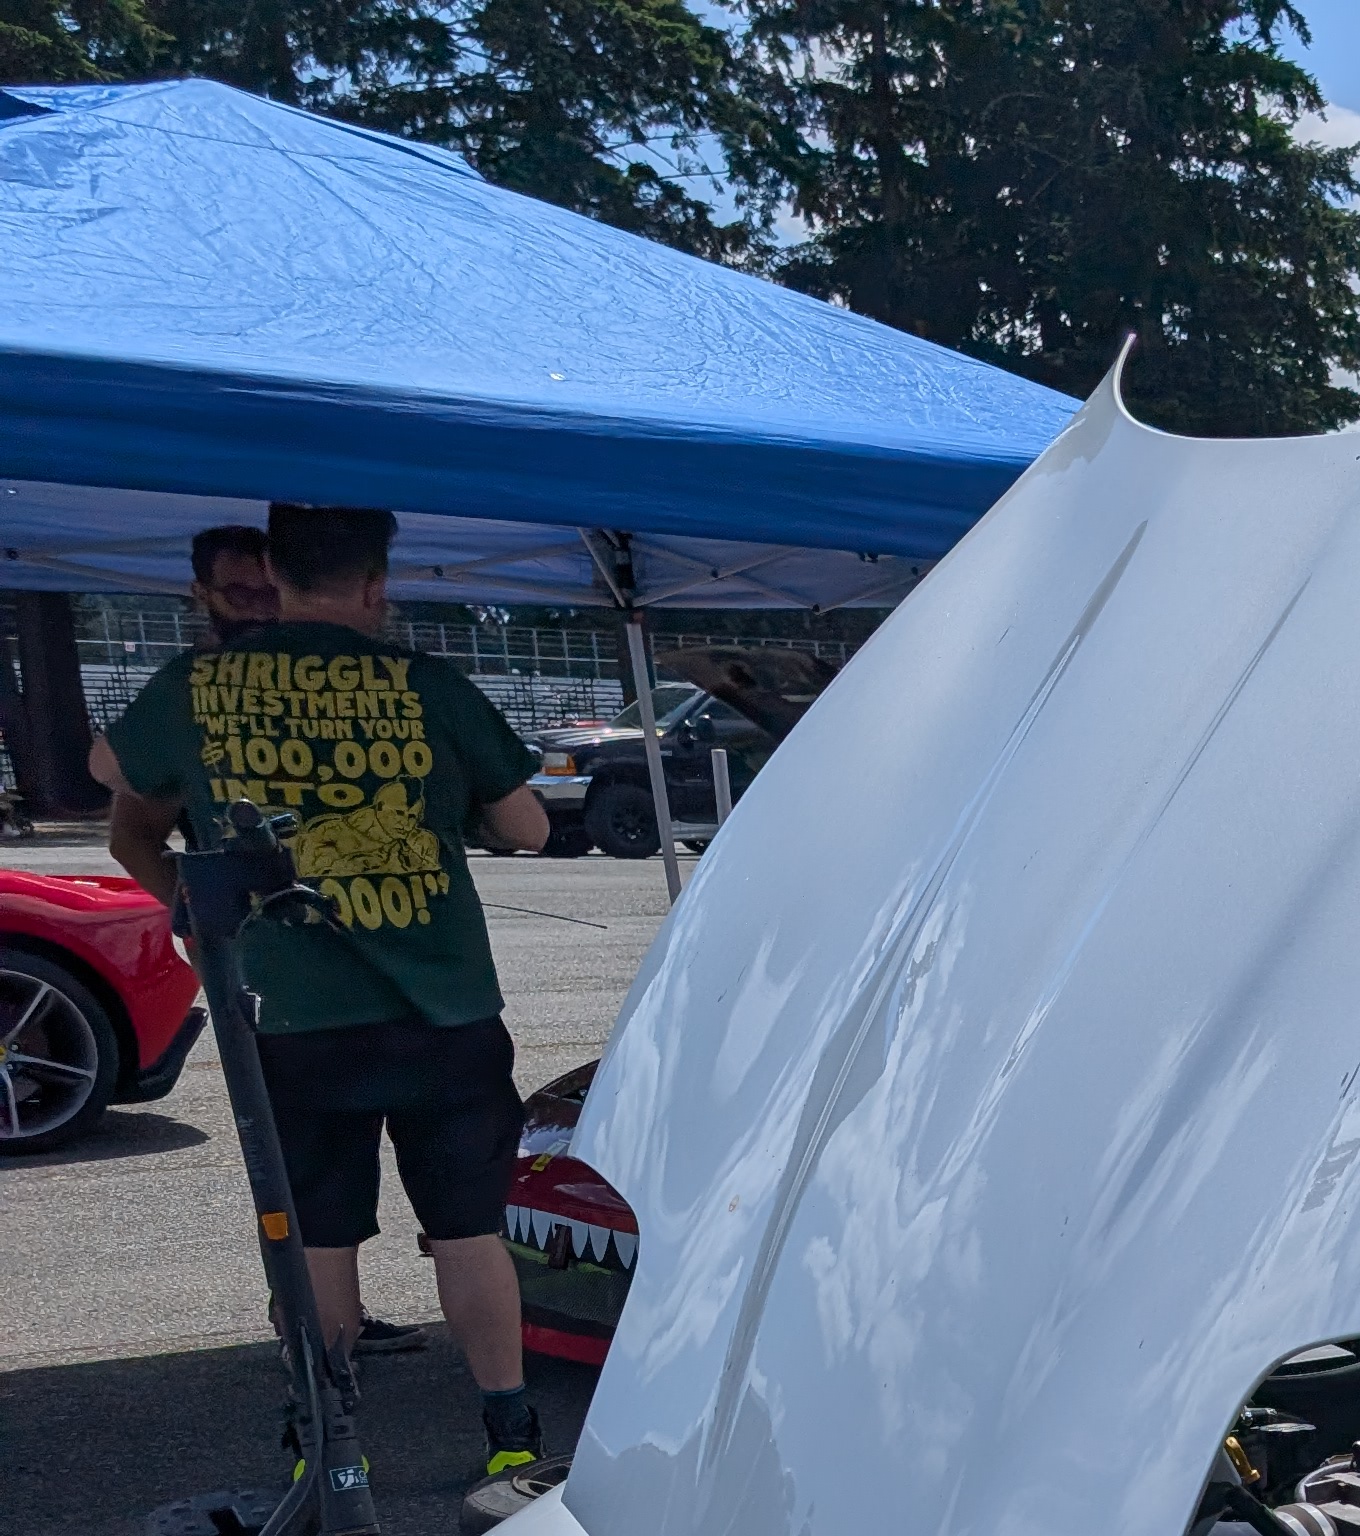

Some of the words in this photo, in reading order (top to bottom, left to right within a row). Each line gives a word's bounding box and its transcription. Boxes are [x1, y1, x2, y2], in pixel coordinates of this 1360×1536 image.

[189, 651, 413, 691] SHRIGGLY
[192, 685, 423, 718] INVESTMENTS
[285, 718, 353, 739] TURN
[358, 719, 426, 740] YOUR
[201, 735, 433, 782] $100,000
[210, 778, 365, 808] INTO
